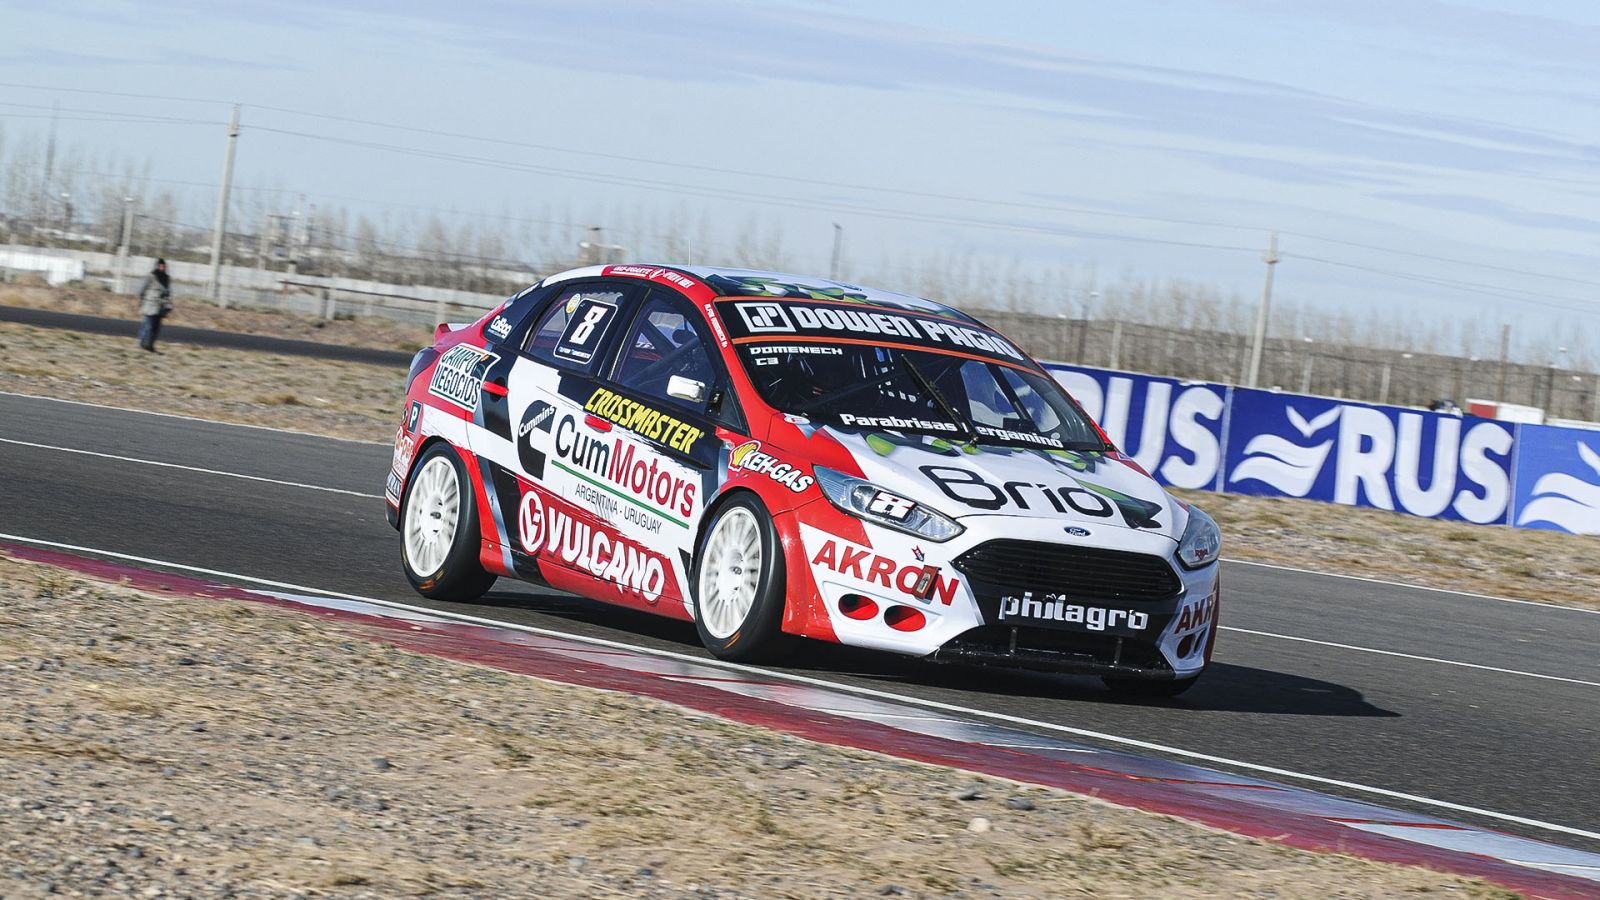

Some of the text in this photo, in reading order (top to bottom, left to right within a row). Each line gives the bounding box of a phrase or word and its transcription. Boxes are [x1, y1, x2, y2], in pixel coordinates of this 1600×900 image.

[569, 306, 608, 345] 8
[750, 346, 843, 355] DOMENECH
[790, 306, 922, 339] DOWEN
[917, 319, 1023, 361] PAGIO
[432, 364, 480, 405] NEGOCIOS
[518, 406, 555, 437] Cummins
[584, 387, 701, 454] CROSSMASTER
[840, 413, 1063, 448] Parabrisas ergamino
[555, 414, 696, 518] CumMotors
[739, 450, 815, 493] KEH-GAS
[1333, 405, 1514, 524] RUS
[575, 483, 619, 516] ARGENTINA
[624, 507, 662, 535] URUGUAY
[919, 465, 1114, 518] Brio
[547, 506, 665, 602] VULCANO
[812, 539, 960, 606] AKRON
[999, 592, 1149, 631] philagro
